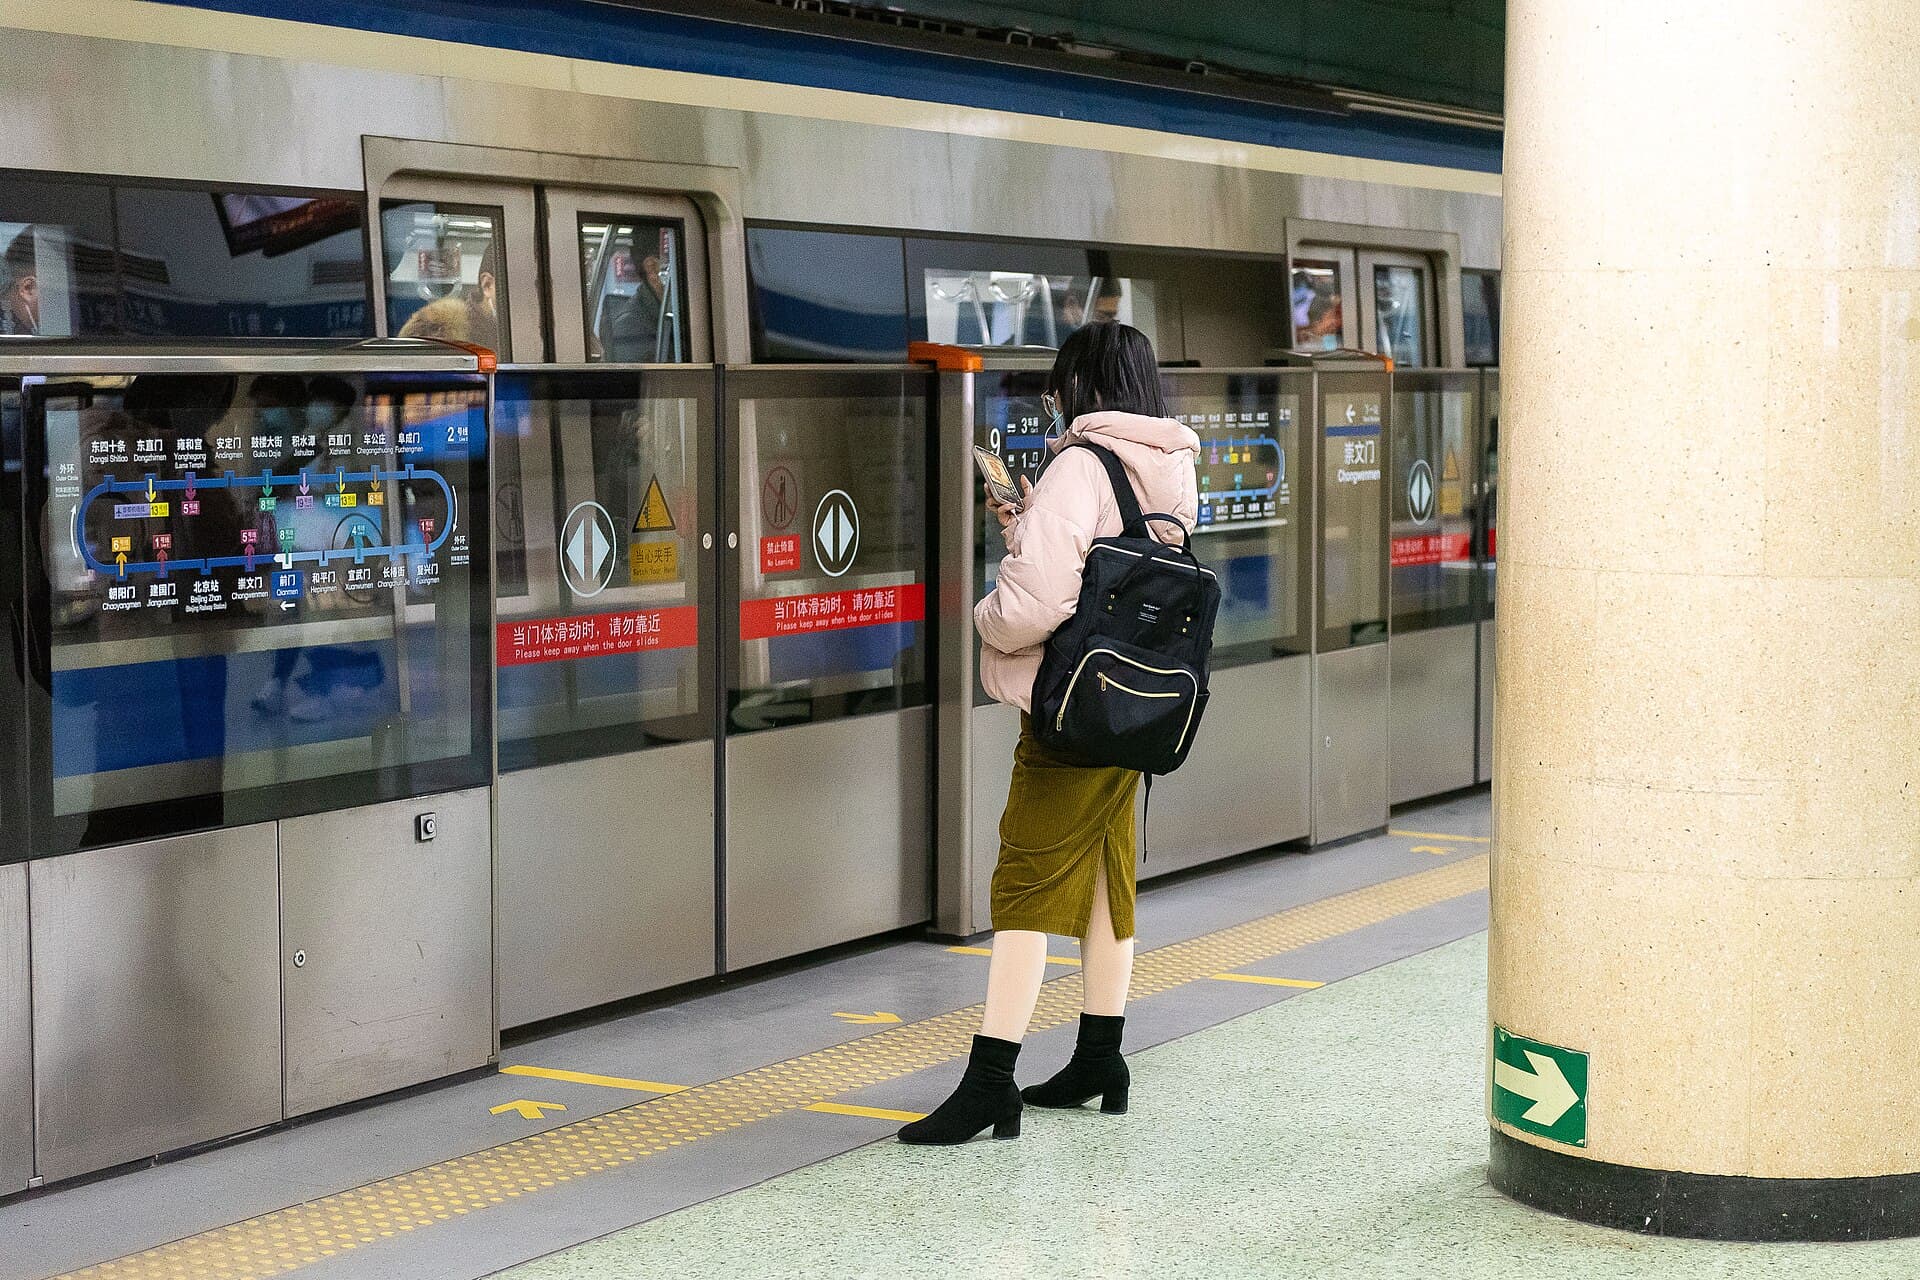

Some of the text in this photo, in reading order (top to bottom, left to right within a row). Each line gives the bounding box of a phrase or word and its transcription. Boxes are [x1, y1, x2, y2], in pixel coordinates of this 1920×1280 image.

[1021, 417, 1028, 434] 3
[177, 438, 202, 450] 雍和宫
[216, 437, 241, 449] 安定门
[251, 436, 282, 449] 鼓楼大街
[292, 435, 316, 448] 积水潭
[328, 434, 352, 446] 西直门
[364, 432, 386, 445] 车公庄
[398, 432, 420, 444] 阜成门
[990, 428, 1000, 456] 9
[91, 440, 126, 453] 东四十条
[136, 439, 162, 452] 东直门
[356, 446, 394, 456] Chegongzhuang
[395, 445, 424, 454] Fuchengmen
[134, 454, 166, 463] Dongzhimen
[174, 452, 206, 462] Yonghegong
[215, 451, 244, 460] Andingmen
[253, 450, 282, 459] Gulou Dajie
[293, 449, 314, 457] Jishuitan
[1344, 440, 1375, 465] 崇文门
[90, 454, 129, 464] Dongsi Shitiao
[1022, 452, 1026, 468] 1
[59, 464, 75, 474] 外环
[766, 540, 794, 554] 禁止倚靠
[636, 546, 672, 563] 当心夹手
[767, 557, 794, 567] No Leaning
[348, 568, 371, 581] 宣武门
[417, 563, 438, 576] 复兴门
[238, 577, 262, 590] 崇文门
[280, 574, 296, 587] 前门
[312, 571, 336, 584] 和平门
[416, 577, 439, 586] Fuxingmen
[150, 583, 176, 597] 建国门
[193, 579, 219, 594] 北京站
[310, 586, 338, 594] Hepingmen
[345, 583, 374, 591] Xuanwumen
[108, 586, 136, 600] 朝阳门
[190, 594, 222, 604] Beijing Zhan
[232, 591, 268, 600] Chongwenmen
[276, 589, 298, 597] Qianmen
[102, 601, 141, 611] Chaoyangmen
[146, 598, 178, 608] Jianguomen
[776, 611, 893, 631] Please keep away when the door slides
[515, 636, 659, 659] Please keep away when the door slides
